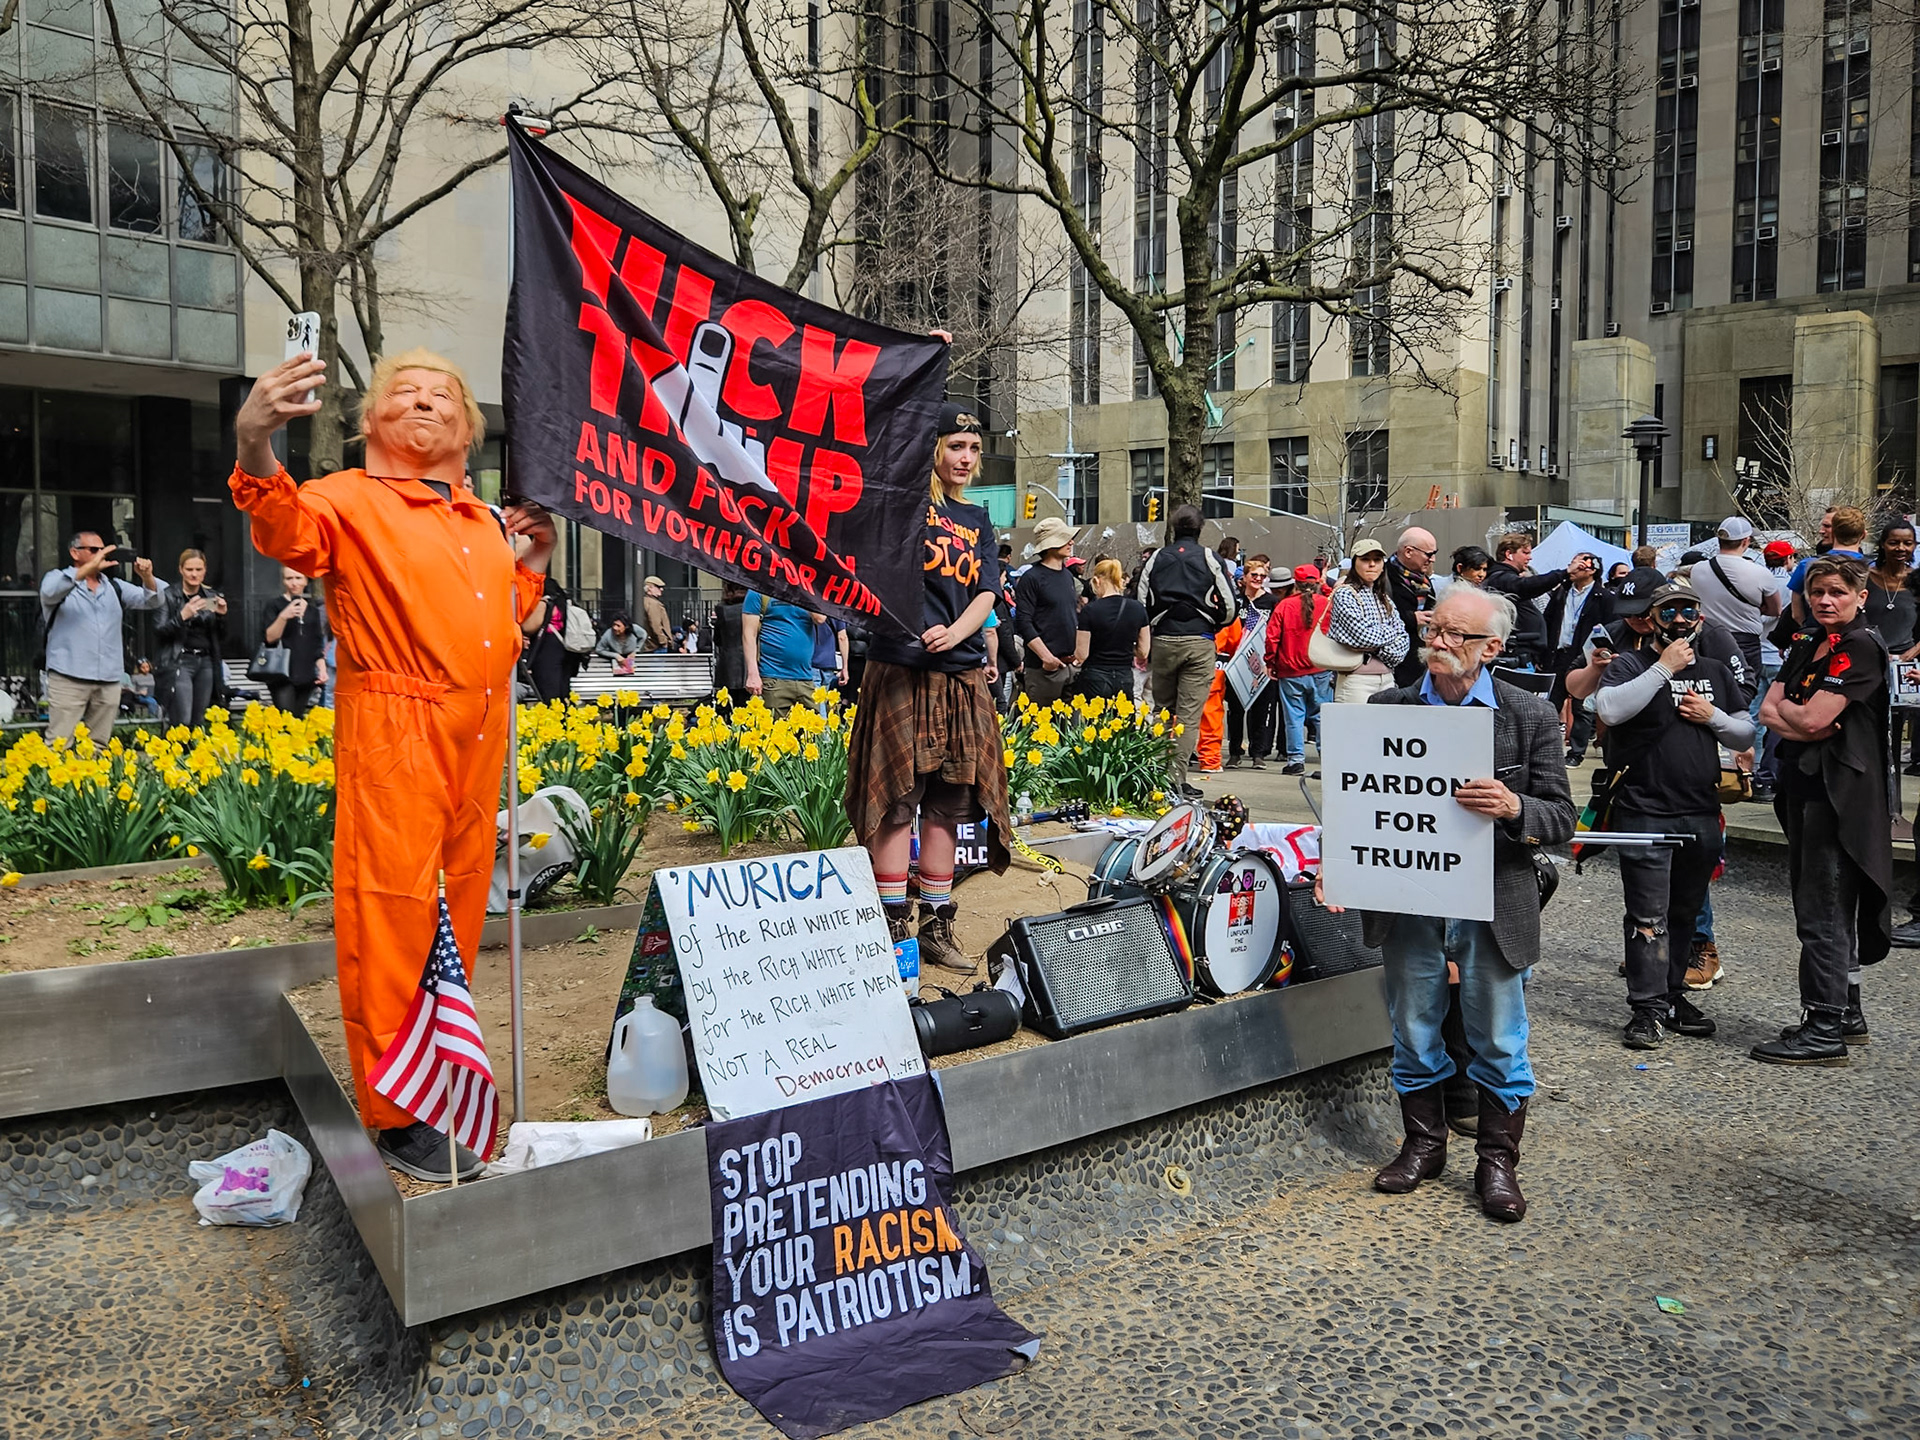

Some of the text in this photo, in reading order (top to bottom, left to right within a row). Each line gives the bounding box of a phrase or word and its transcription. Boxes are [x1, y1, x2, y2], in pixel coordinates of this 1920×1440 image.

[576, 421, 677, 495] AND
[689, 465, 800, 549] FUCK
[575, 470, 883, 617] FOR VOTING FOR HIM
[1383, 737, 1428, 758] NO
[1341, 772, 1470, 797] PARDON
[1375, 810, 1437, 834] FOR
[669, 853, 853, 917] 'MURICA
[1036, 856, 1063, 874] CRO
[1350, 845, 1462, 872] TRUMP
[678, 905, 882, 969] of the RICH WHITE MEN
[1068, 920, 1126, 941] CUBE
[1230, 929, 1250, 937] UNFUCK
[1230, 945, 1248, 953] WORLD
[688, 936, 888, 1015] by the RICH WHITE MEN
[701, 1011, 732, 1056] for
[740, 1009, 766, 1031] the
[816, 981, 857, 1008] WHITE
[863, 974, 899, 998] MEN
[706, 1033, 837, 1086] NOT A REAL
[775, 1054, 892, 1098] Democracy
[719, 1131, 801, 1200] STOP
[722, 1158, 927, 1254] PRETENDING
[724, 1206, 963, 1302] YOUR RACISM
[724, 1251, 981, 1361] IS PATRIOTISM.
